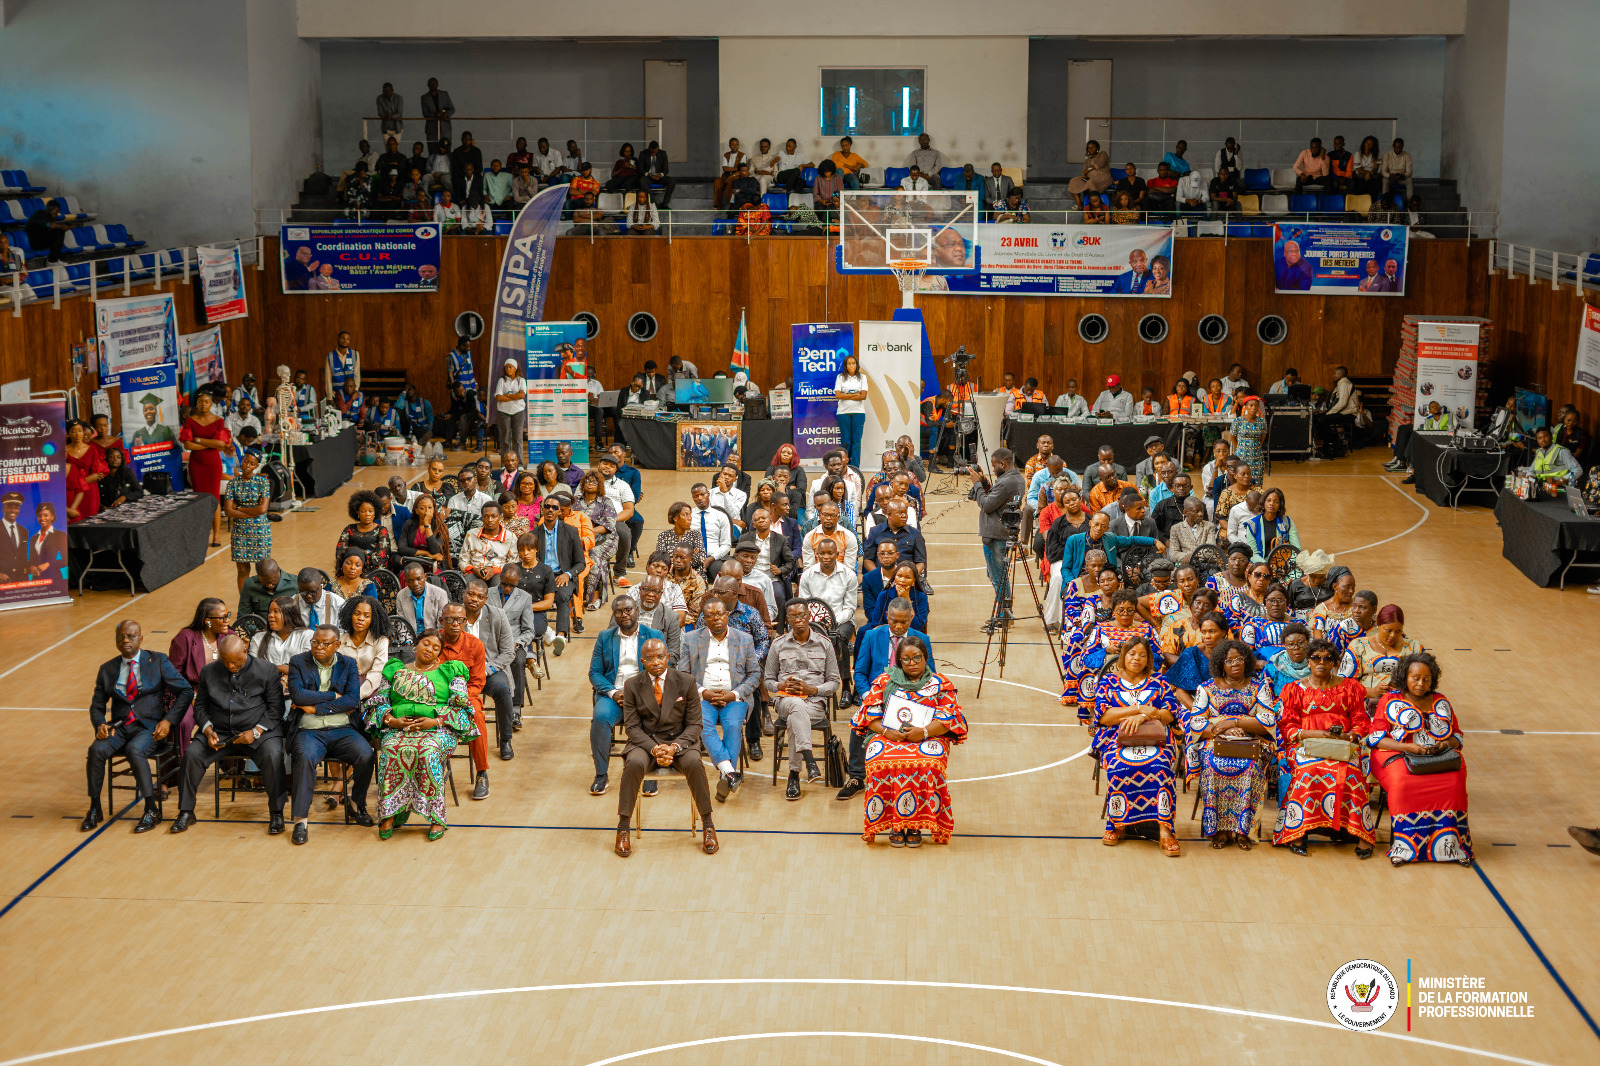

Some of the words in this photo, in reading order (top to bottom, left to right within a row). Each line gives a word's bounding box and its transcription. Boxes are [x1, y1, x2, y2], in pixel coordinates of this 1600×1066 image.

[316, 242, 372, 250] Coordination
[375, 242, 416, 250] Nationale
[1000, 238, 1012, 247] 23
[1014, 238, 1038, 248] AVRIL
[1082, 236, 1101, 246] BUK
[339, 252, 391, 260] C.U.R
[500, 233, 538, 316] ISIPA
[530, 278, 542, 320] Programmation
[868, 342, 912, 352] rawbank
[798, 358, 836, 372] Tech
[801, 387, 837, 396] MineTec
[798, 426, 841, 434] LANCEME
[806, 437, 842, 445] OFFICIE
[0, 457, 47, 467] FORMATION
[38, 464, 59, 473] L'AIR
[8, 473, 49, 484] STEWARD
